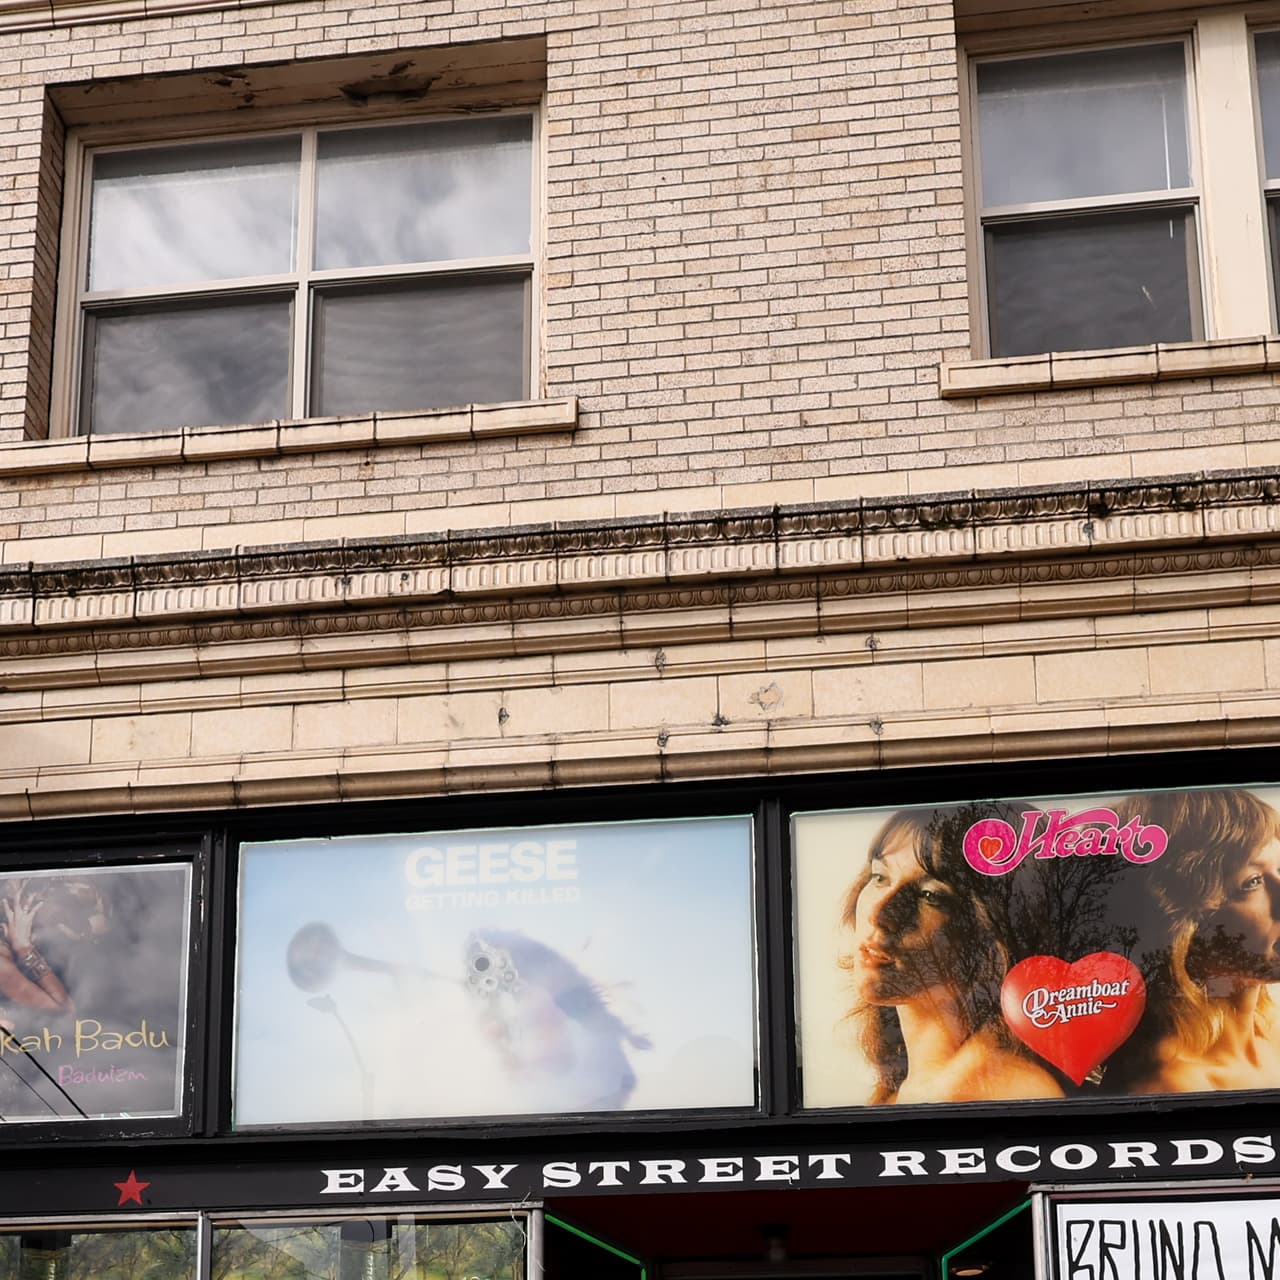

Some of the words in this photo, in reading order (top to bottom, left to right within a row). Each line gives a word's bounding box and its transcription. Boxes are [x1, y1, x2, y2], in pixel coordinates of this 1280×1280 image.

[404, 839, 580, 888] GEESE
[963, 807, 1170, 877] Heart
[405, 888, 499, 912] GETTING
[505, 884, 583, 905] KILLED
[1022, 977, 1131, 1021] Dreamboat
[1028, 999, 1118, 1028] Annie
[75, 1019, 170, 1059] Badu
[320, 1163, 520, 1195] EASY
[541, 1153, 851, 1189] STREET
[877, 1134, 1278, 1178] RECORDS
